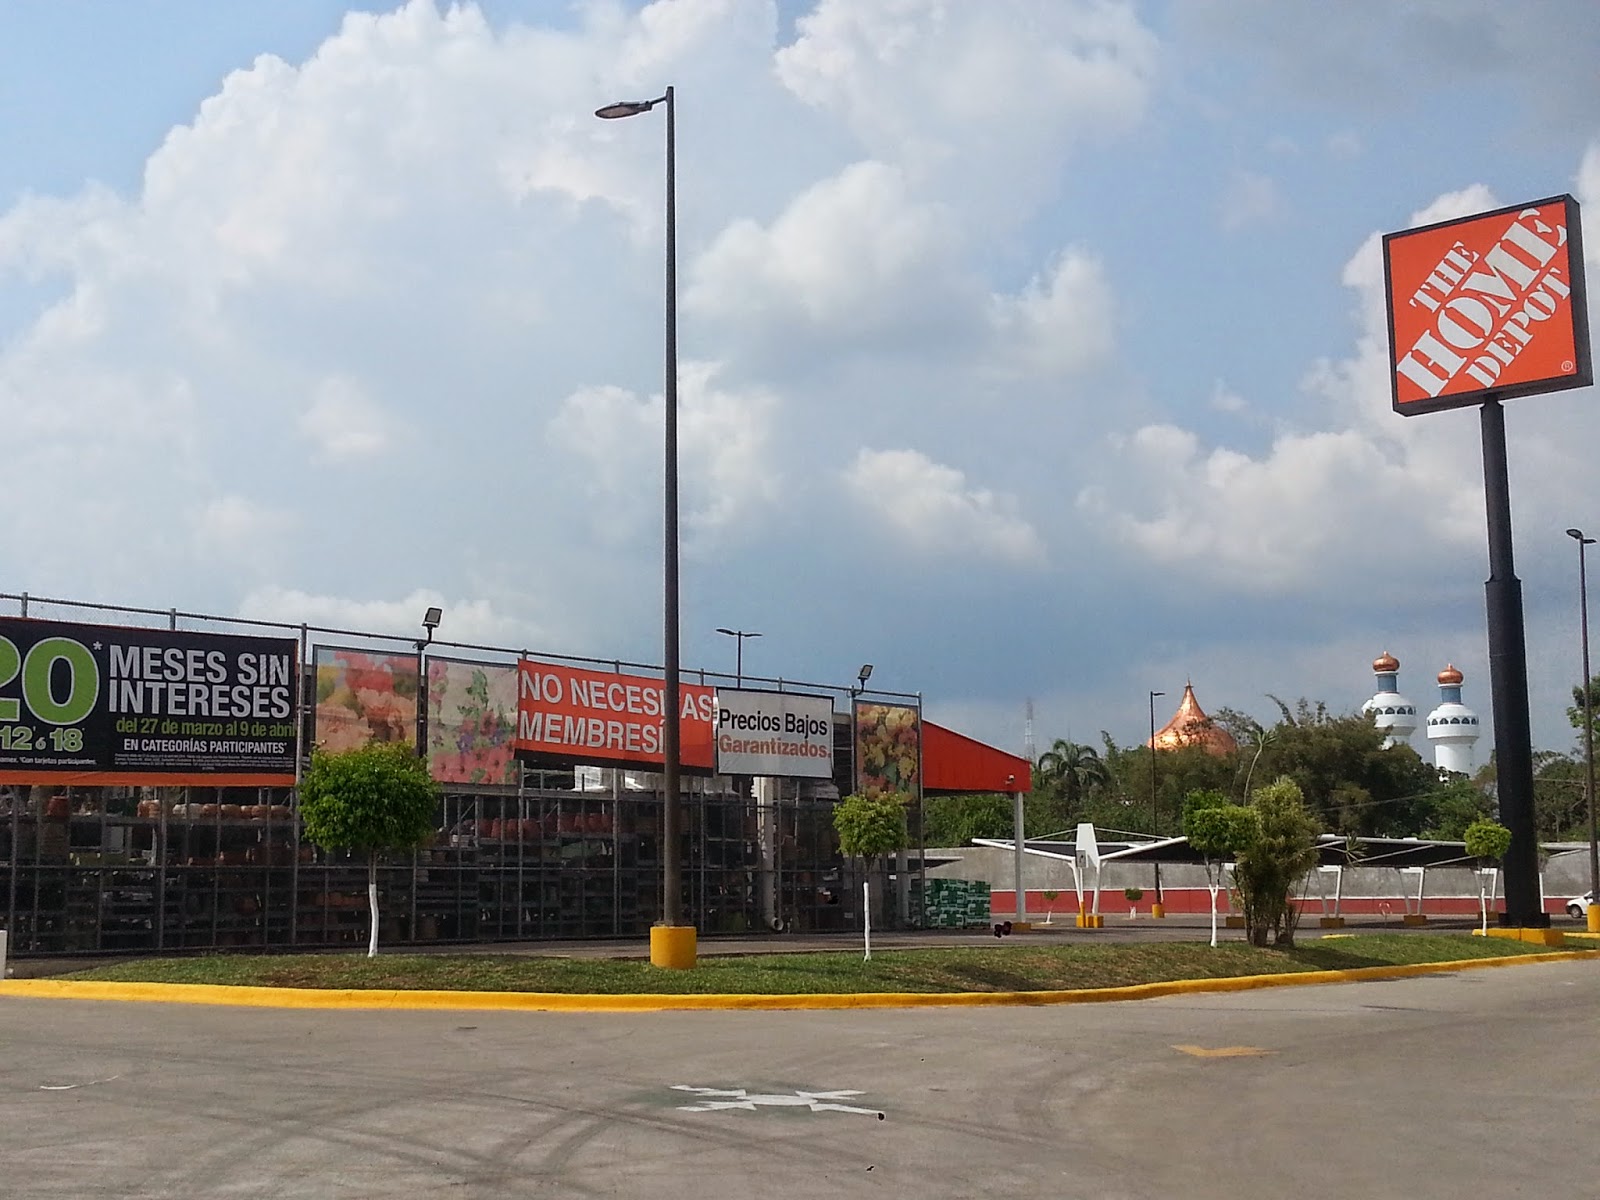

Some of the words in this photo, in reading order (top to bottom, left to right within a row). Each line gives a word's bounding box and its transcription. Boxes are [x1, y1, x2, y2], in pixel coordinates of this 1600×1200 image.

[1409, 240, 1480, 313] THE
[1396, 207, 1568, 398] HOME
[1464, 266, 1571, 388] DEPOT
[109, 644, 228, 684] MESES
[237, 652, 290, 686] SIN
[108, 679, 291, 719] INTERESES
[521, 670, 563, 703] NO
[570, 677, 713, 722] NECESIAS
[116, 717, 138, 733] del
[140, 718, 159, 735] 27
[161, 718, 179, 735] de
[181, 721, 223, 737] marzo
[225, 720, 237, 737] al
[239, 721, 249, 737] 9
[251, 721, 267, 738] de
[268, 721, 296, 738] abril
[518, 710, 681, 755] MEMBRESÍ
[719, 708, 781, 732] Precios
[784, 712, 828, 739] Bajos
[123, 738, 139, 751] EN
[141, 738, 208, 753] CATEGORÍAS
[719, 734, 832, 759] Garantizados.
